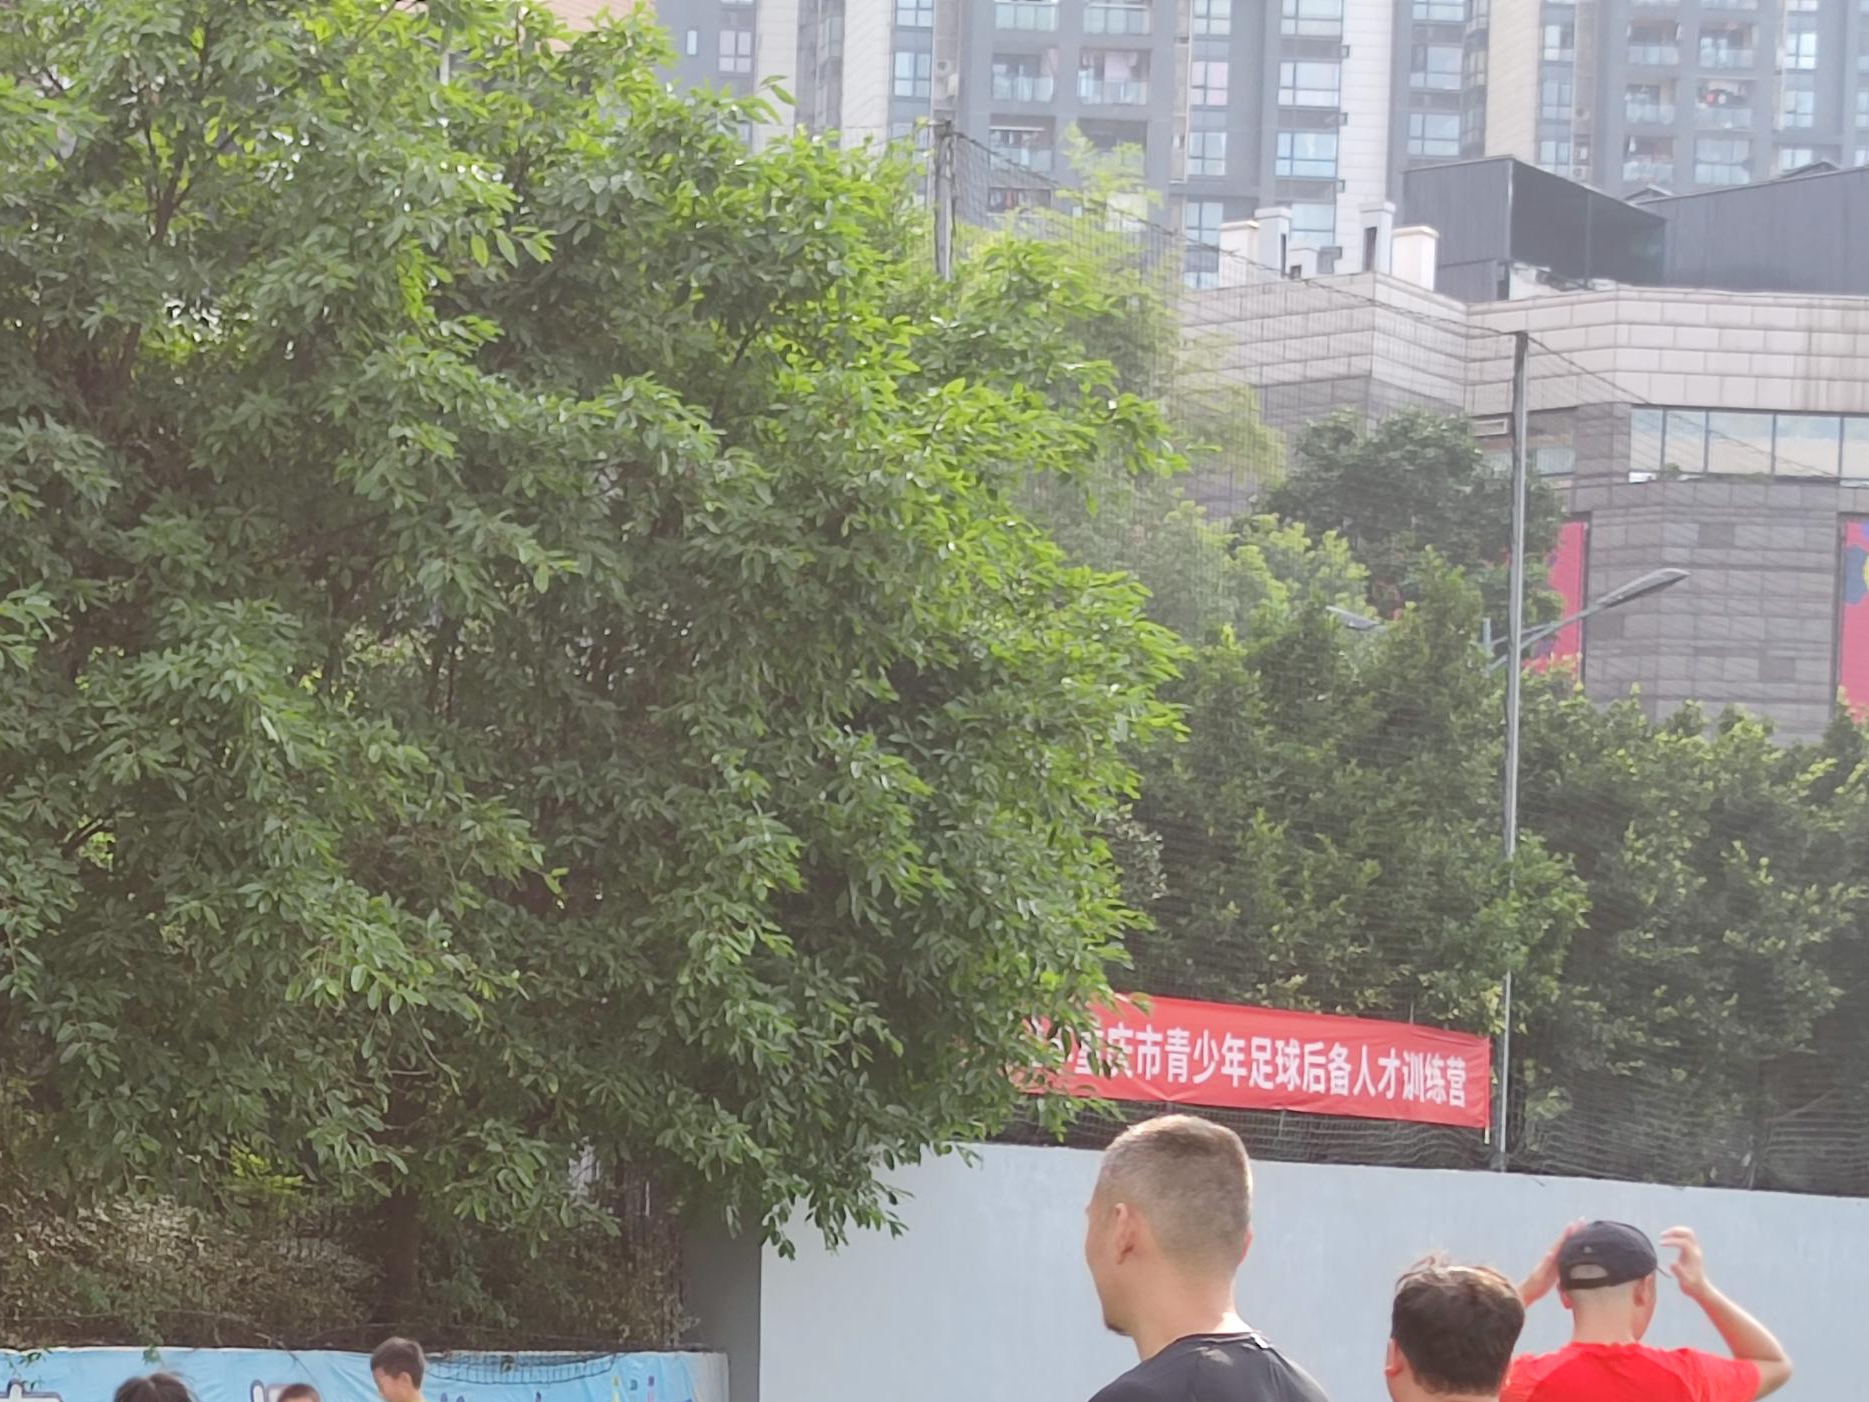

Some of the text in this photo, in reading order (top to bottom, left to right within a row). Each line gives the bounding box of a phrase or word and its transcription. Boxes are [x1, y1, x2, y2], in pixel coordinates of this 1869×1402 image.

[1030, 1018, 1466, 1108] 重庆市青少年足球后备人才训练营
